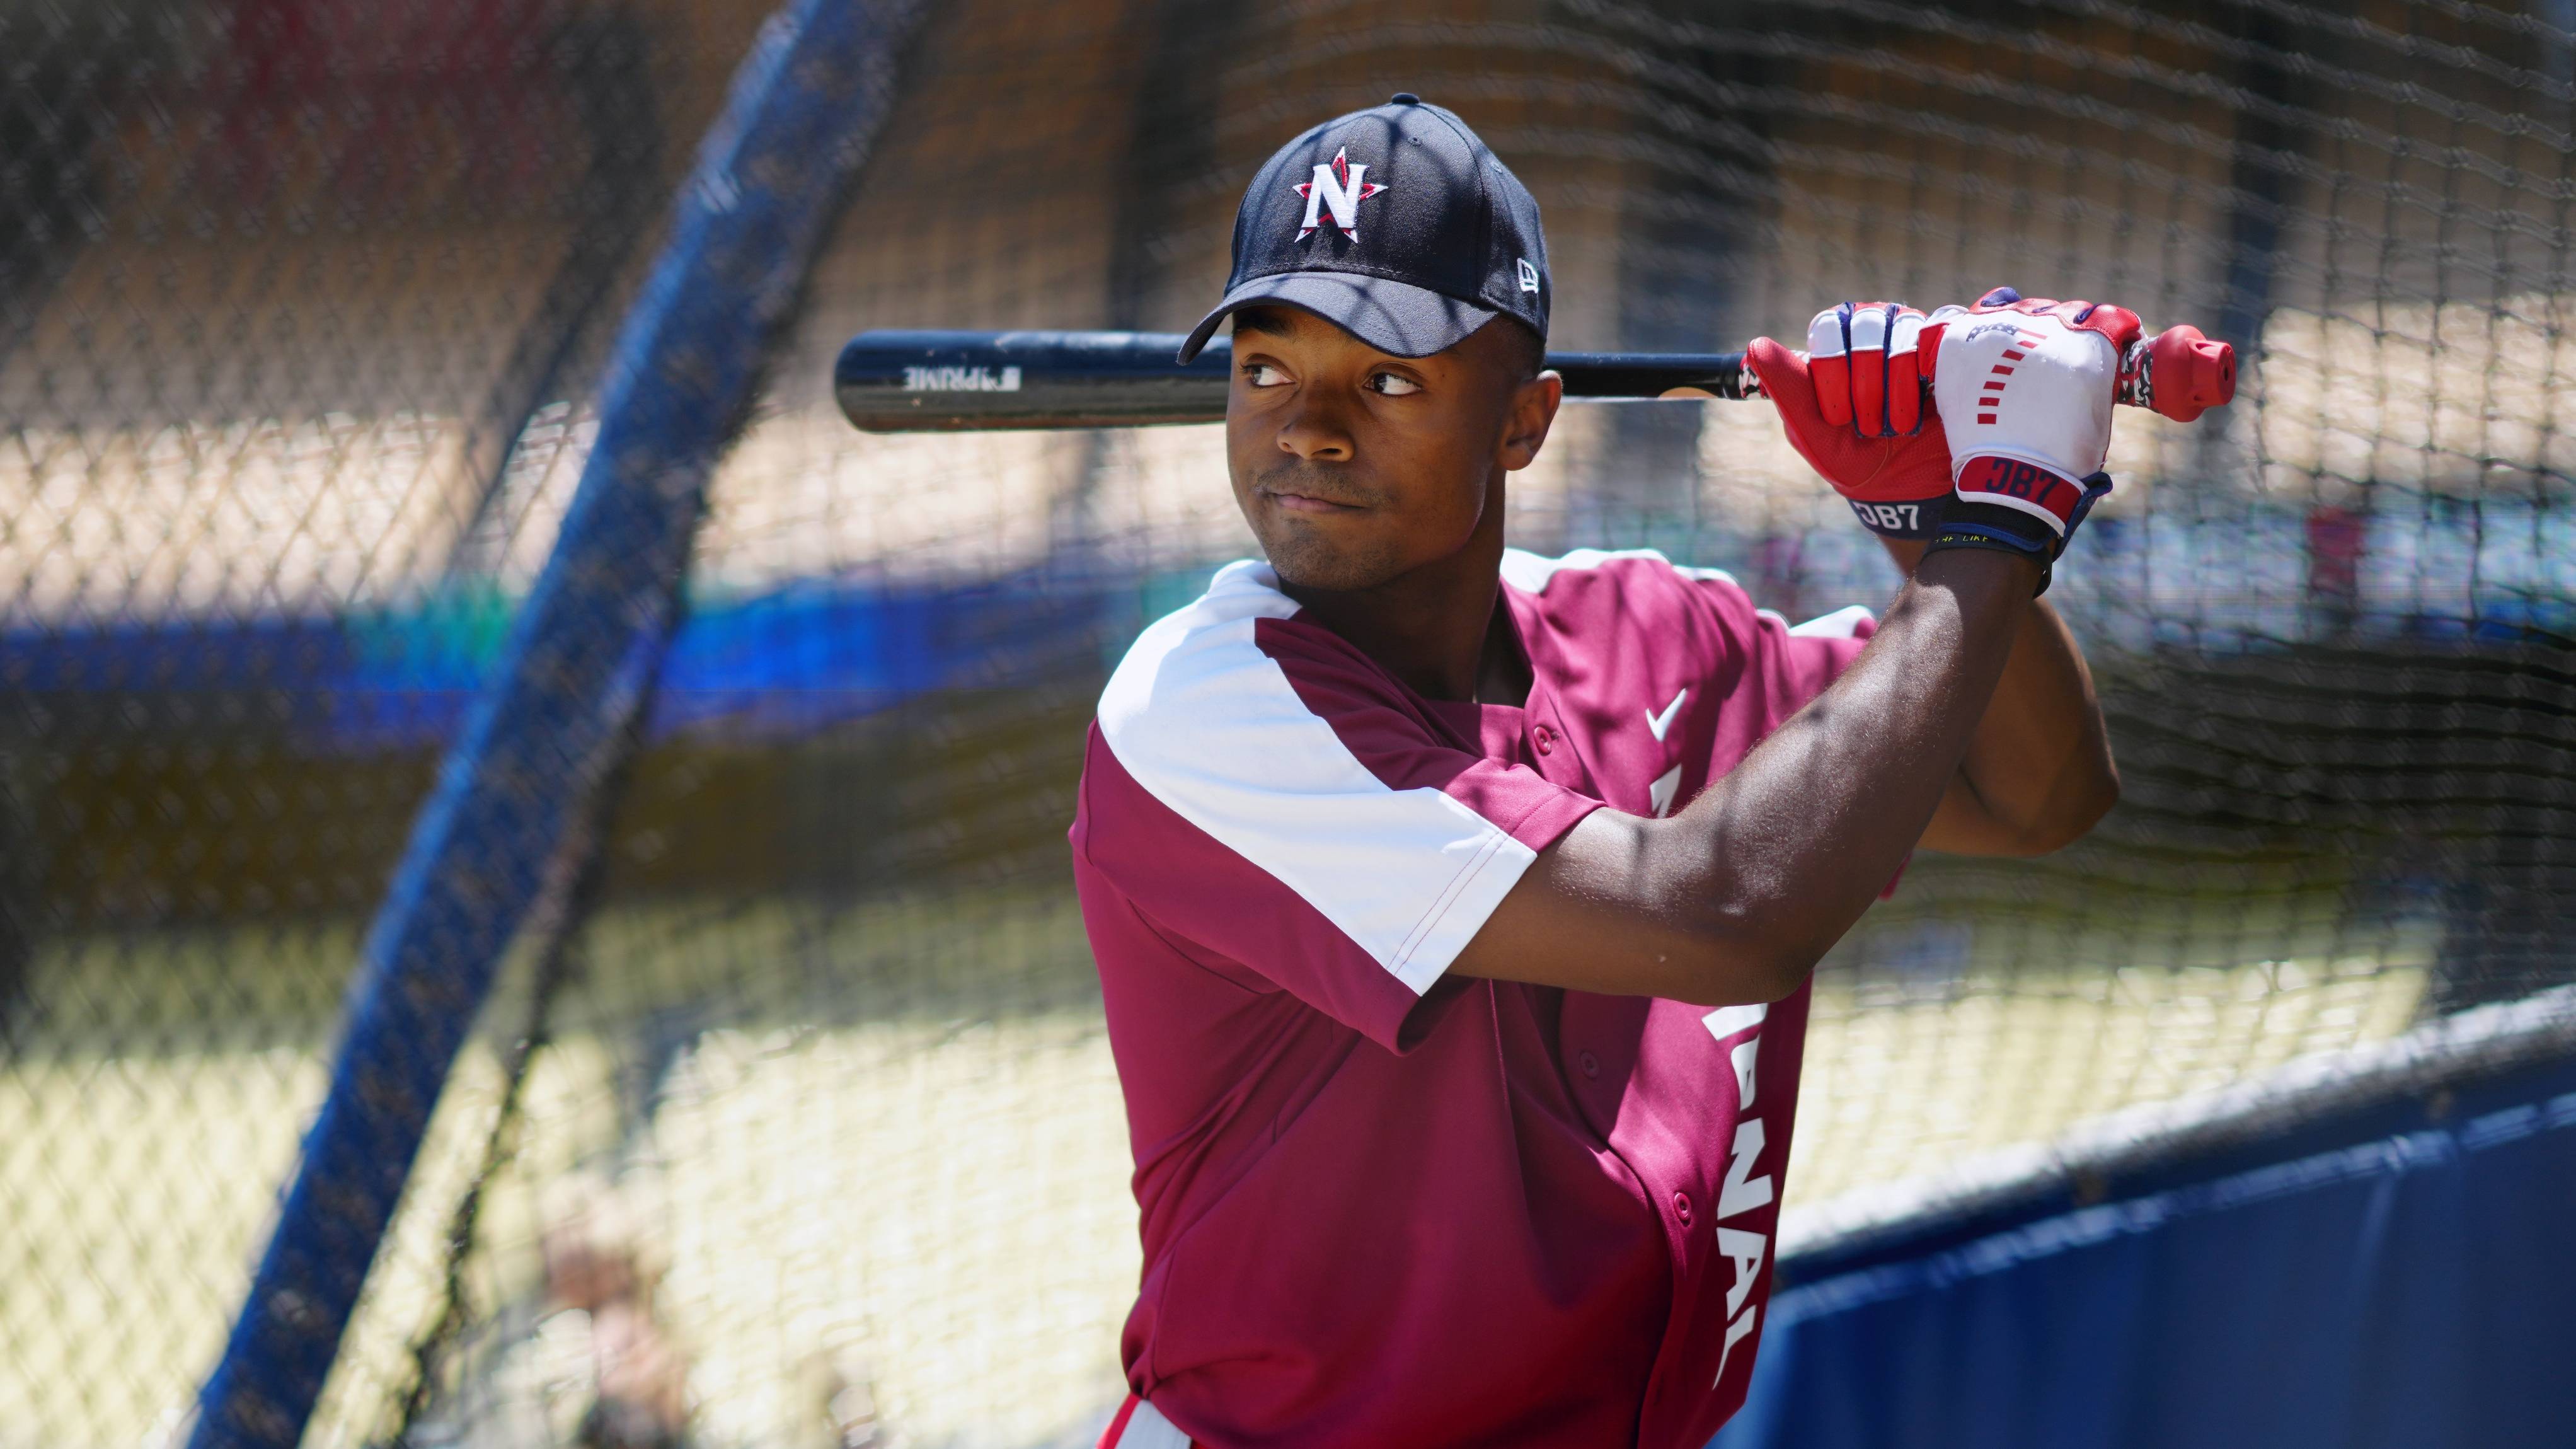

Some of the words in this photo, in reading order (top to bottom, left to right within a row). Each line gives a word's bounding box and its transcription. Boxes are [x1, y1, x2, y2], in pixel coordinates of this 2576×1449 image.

[1302, 164, 1369, 228] N
[903, 367, 980, 391] PRIME
[1986, 459, 2060, 504] JB7
[1853, 501, 1919, 531] JB7
